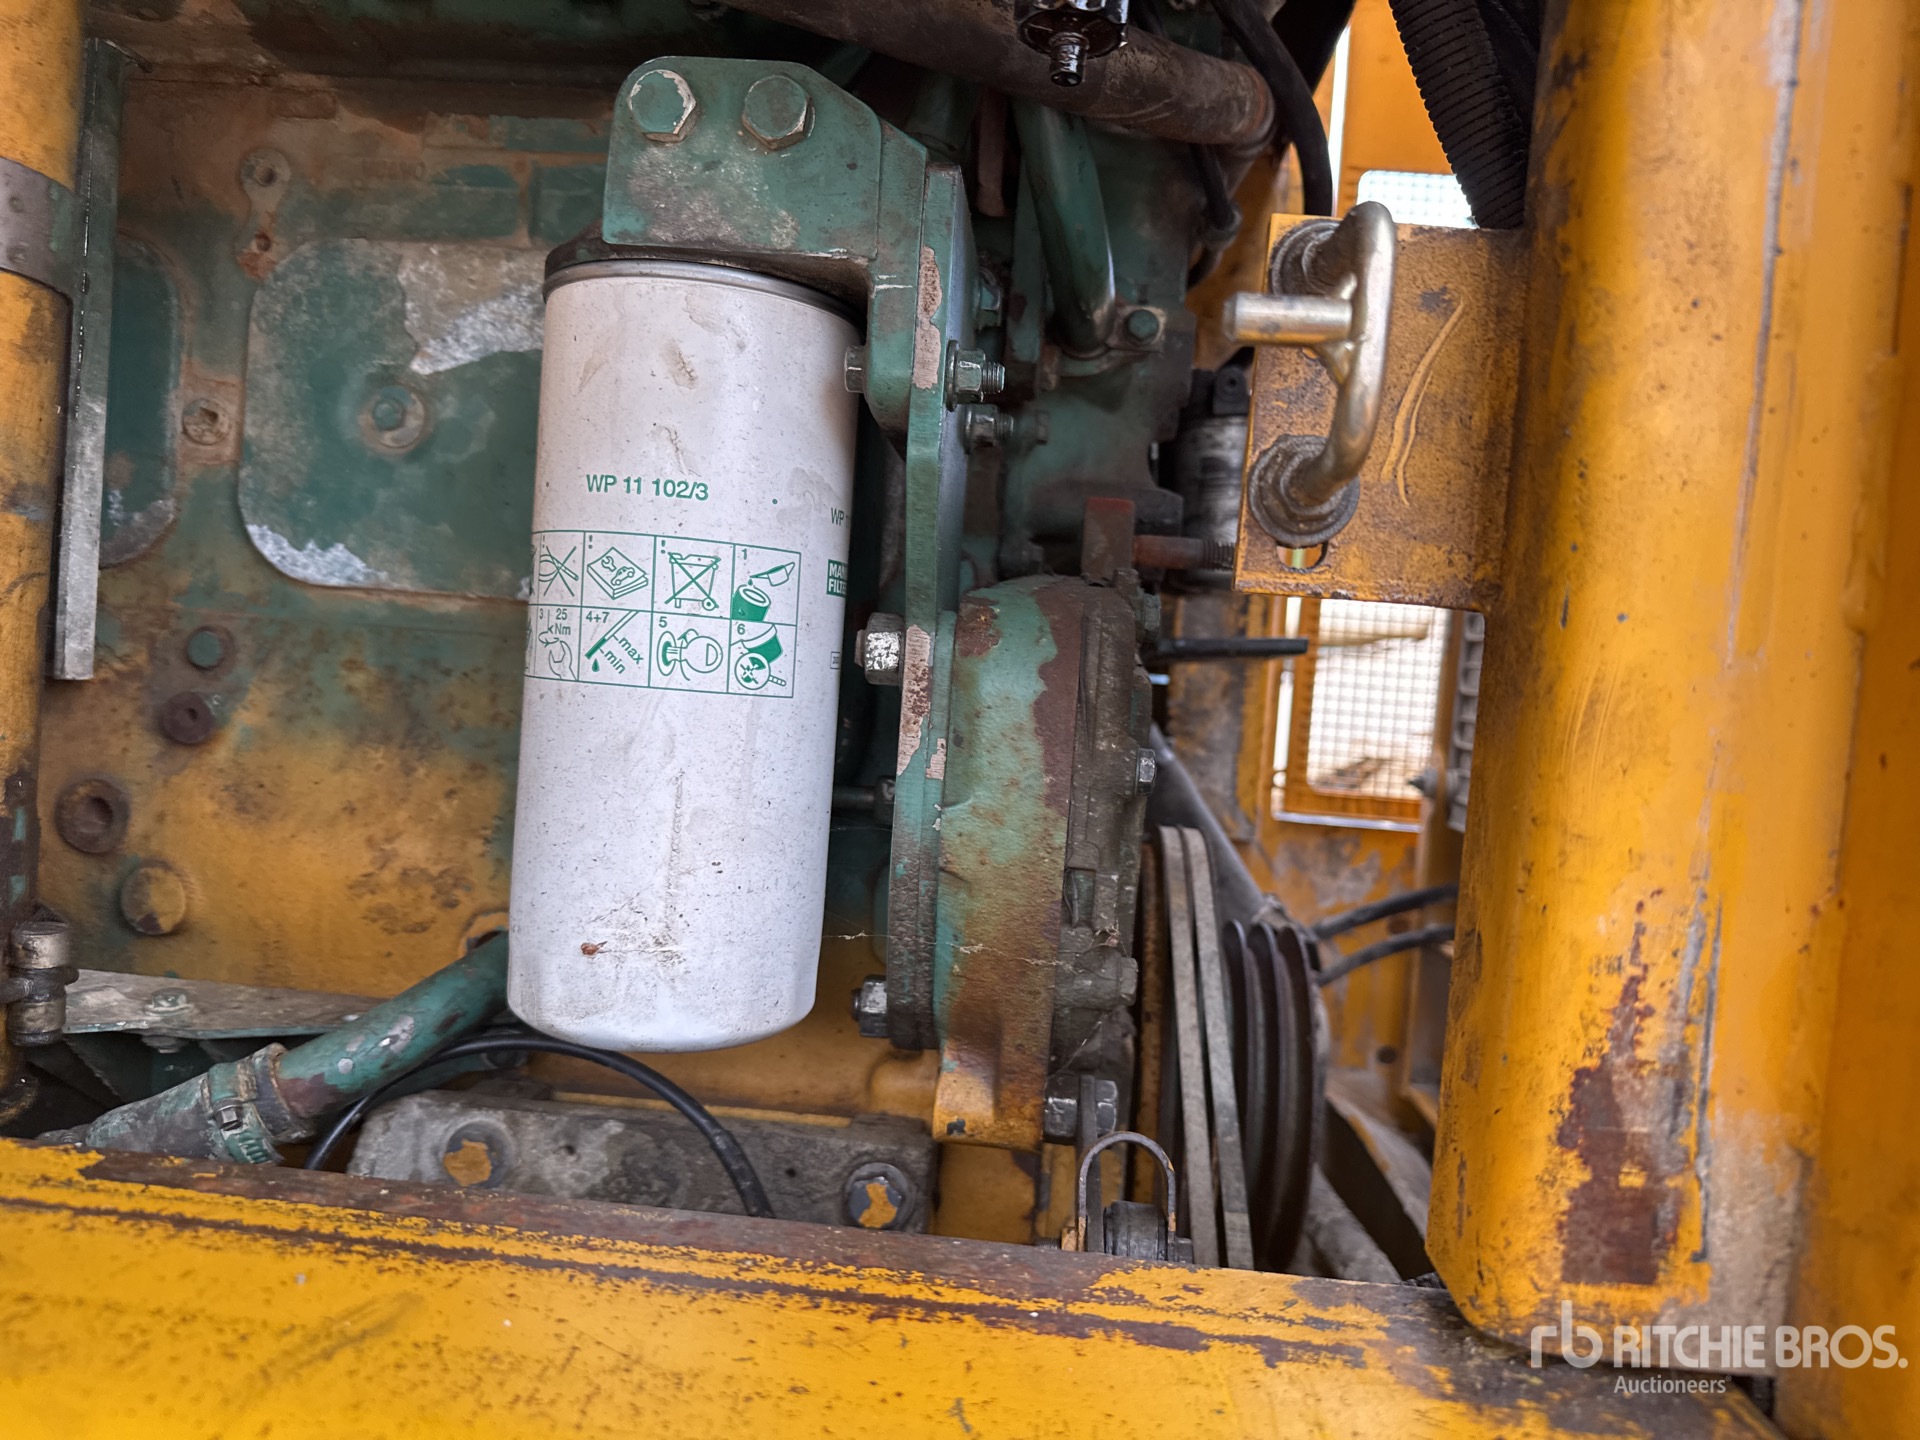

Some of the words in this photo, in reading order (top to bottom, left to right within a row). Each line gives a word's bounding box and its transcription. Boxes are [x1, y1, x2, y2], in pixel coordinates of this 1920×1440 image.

[586, 474, 617, 493] WP
[623, 476, 642, 494] 11
[652, 478, 709, 501] 102/3
[831, 507, 845, 526] WP
[741, 548, 748, 560] 1
[829, 562, 848, 580] MAN
[828, 578, 848, 595] FILTE
[539, 608, 544, 620] 3
[556, 608, 568, 620] 25
[586, 610, 610, 624] 4+7
[554, 622, 572, 636] Nm
[659, 616, 668, 628] 5
[737, 623, 746, 635] 6
[618, 637, 644, 665] max
[604, 650, 626, 674] min
